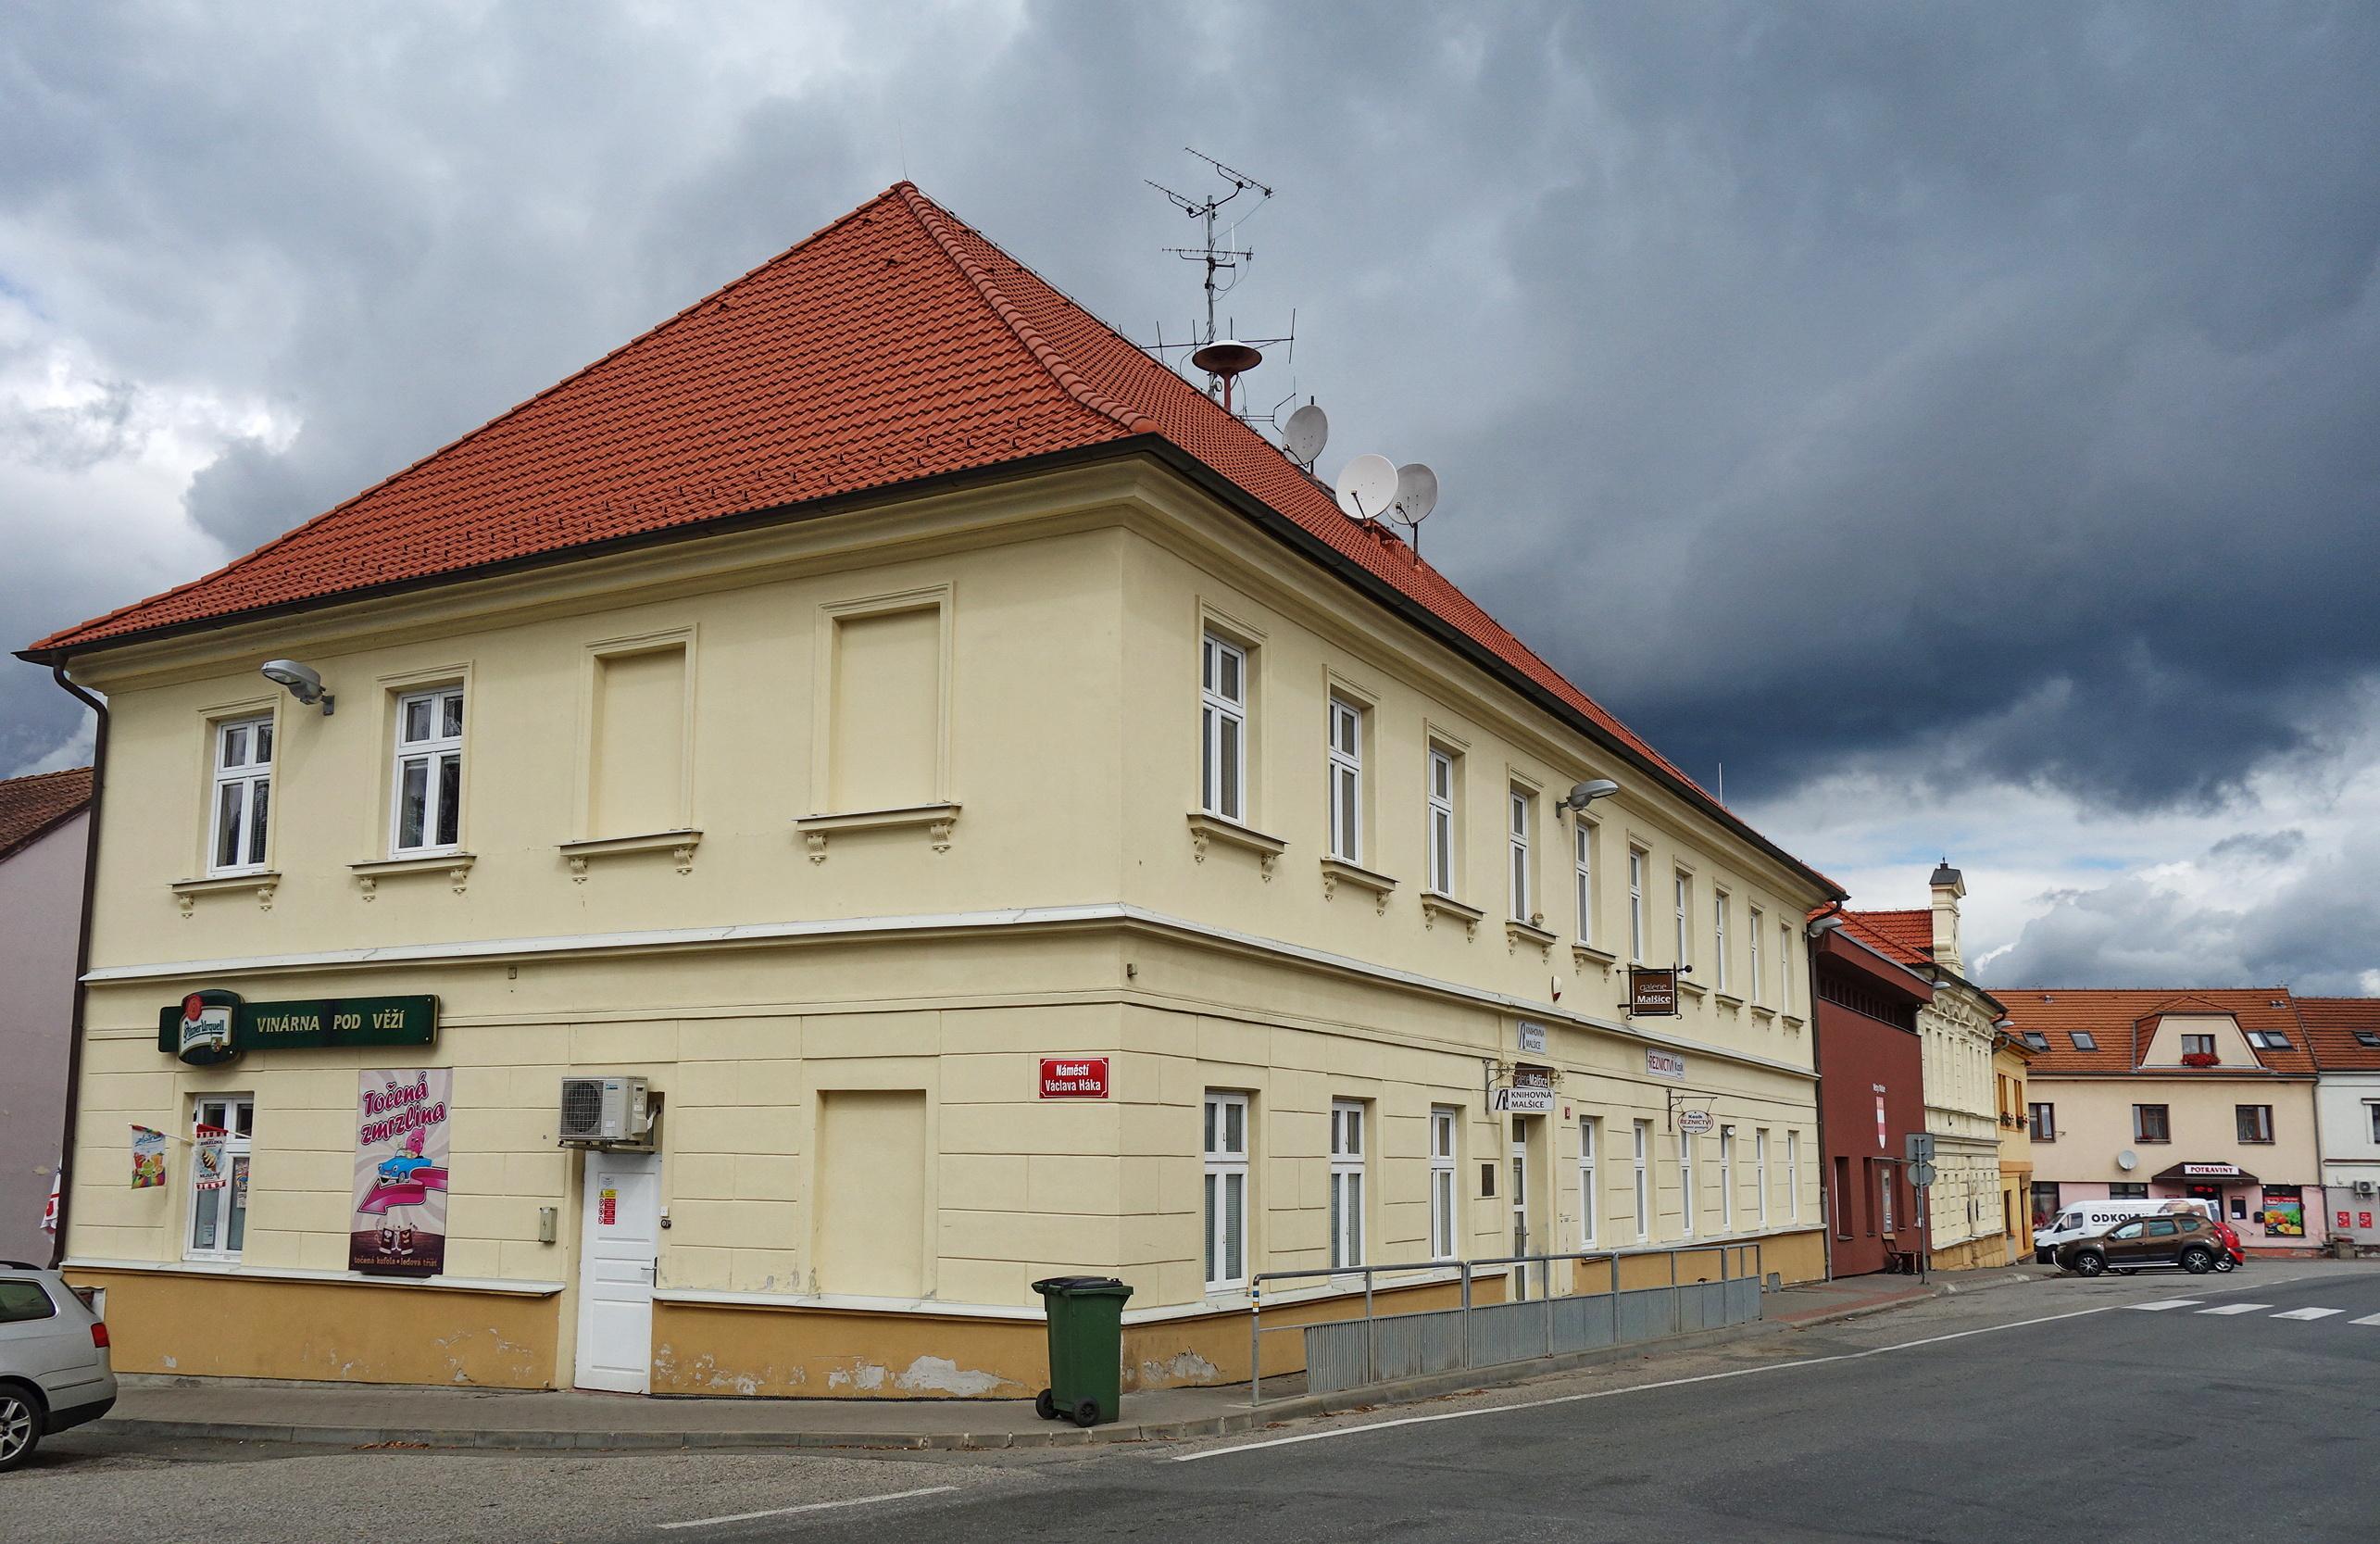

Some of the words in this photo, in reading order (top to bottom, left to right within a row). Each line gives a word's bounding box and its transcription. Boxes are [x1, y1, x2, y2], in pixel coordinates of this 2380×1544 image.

[1639, 982, 1667, 993] galerie
[1637, 995, 1671, 1003] Malšice
[257, 1013, 320, 1033] VINÁRNA
[333, 1013, 361, 1030] POD
[372, 1008, 406, 1030] VĚŽÍ
[201, 1019, 225, 1036] Urquell
[1525, 1025, 1545, 1037] KNIHOVNA
[1525, 1039, 1541, 1049] MALŠICE
[1648, 1051, 1674, 1073] ŘEZNICTVÍ
[1056, 1063, 1090, 1076] Náměstí
[1045, 1079, 1077, 1091] Václava
[1079, 1078, 1101, 1091] Háka
[363, 1072, 429, 1117] Točená
[361, 1101, 446, 1145] zmrzlina
